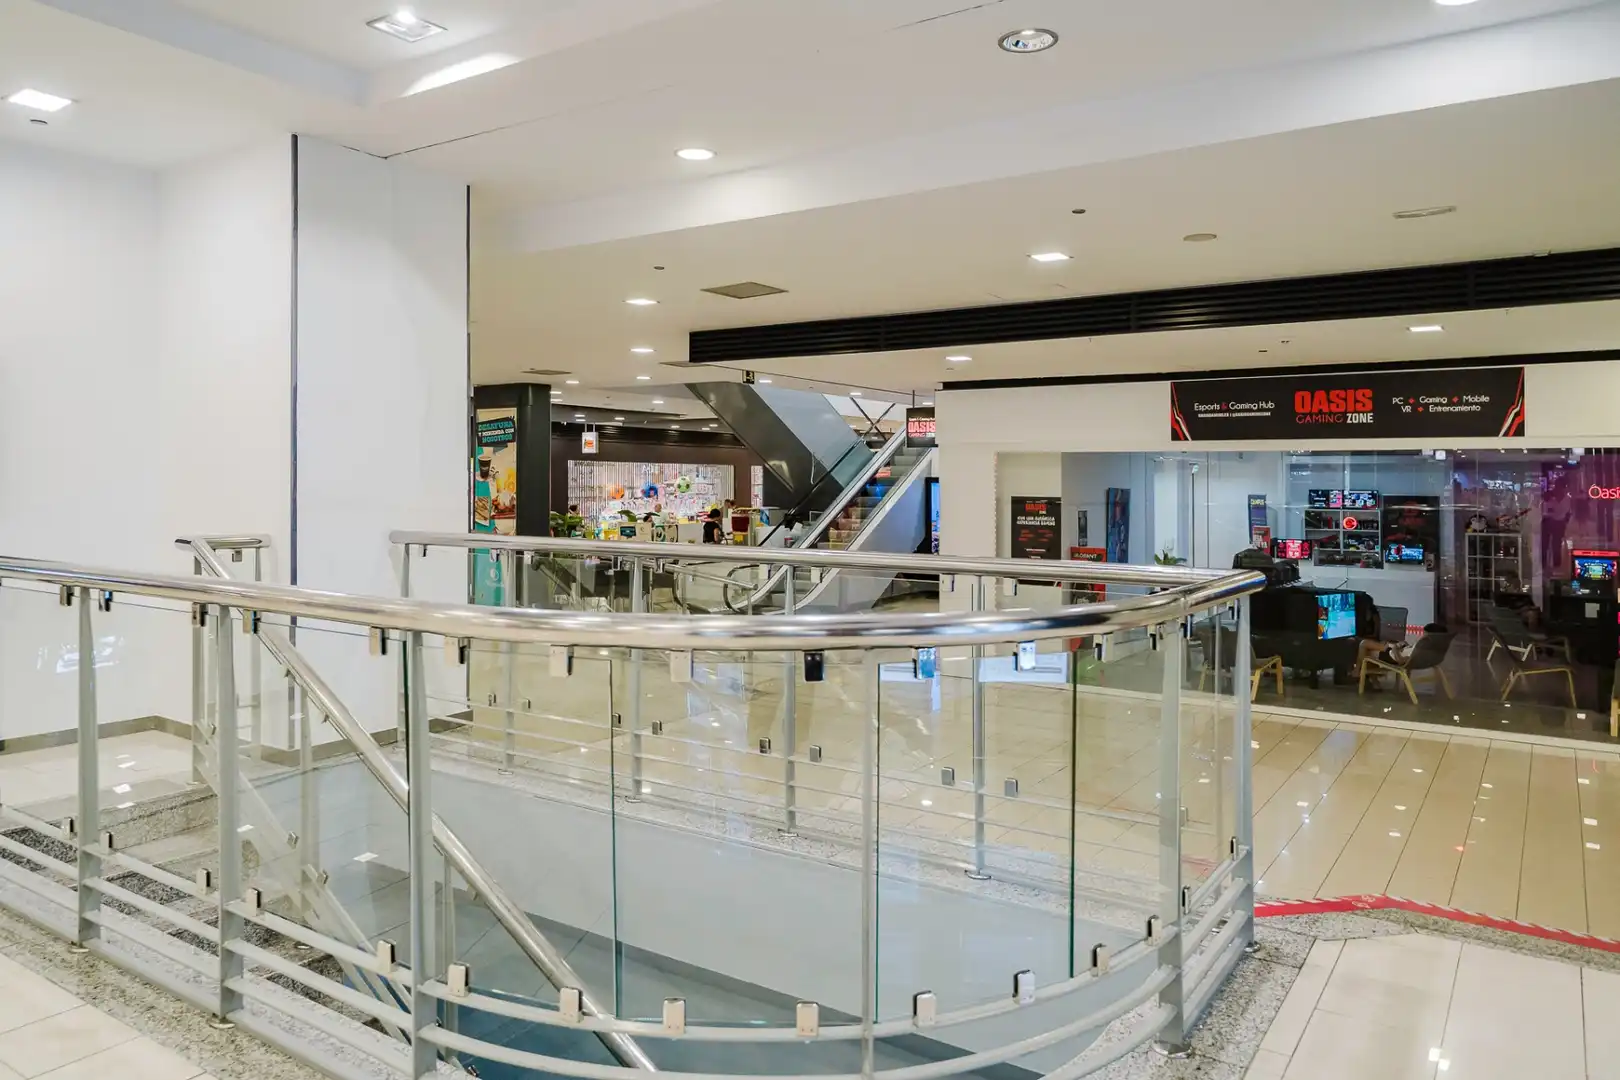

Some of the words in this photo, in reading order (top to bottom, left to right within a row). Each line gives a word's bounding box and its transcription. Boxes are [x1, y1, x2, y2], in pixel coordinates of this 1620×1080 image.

[1294, 388, 1373, 413] OASIS
[1392, 397, 1404, 405] PC
[1419, 395, 1448, 404] Gaming
[1463, 394, 1490, 403] Mobile
[1194, 402, 1220, 412] Esports
[1228, 401, 1258, 411] Gaming
[1259, 400, 1275, 409] Hub
[1401, 405, 1412, 413] VR
[1429, 404, 1481, 412] Entrenamiento
[1295, 413, 1344, 424] GAMING
[1346, 412, 1374, 424] ZONE
[908, 421, 936, 433] OASIS
[1588, 484, 1620, 499] Oasi
